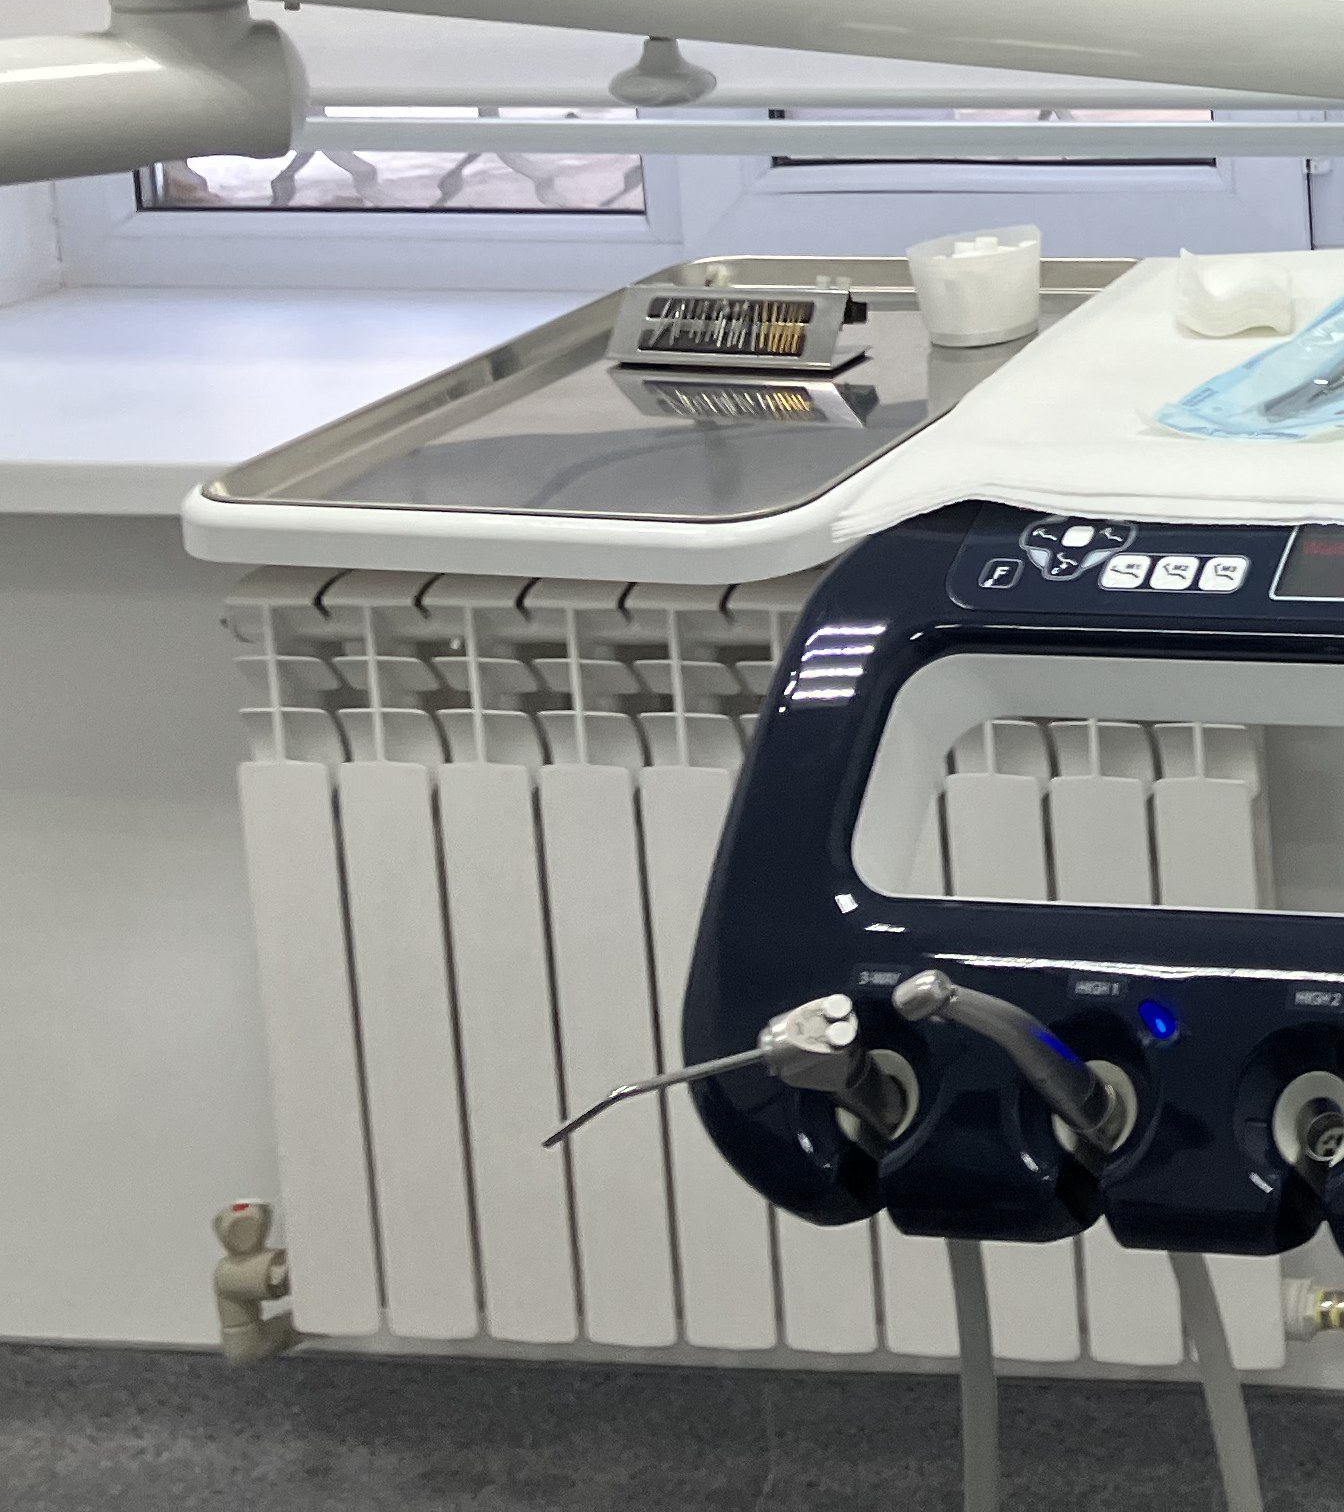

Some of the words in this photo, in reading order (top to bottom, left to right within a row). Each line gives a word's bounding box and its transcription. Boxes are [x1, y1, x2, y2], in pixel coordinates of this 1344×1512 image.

[994, 565, 1010, 582] F
[1173, 564, 1189, 572] M2
[1075, 980, 1110, 995] HIGH
[1295, 991, 1329, 1005] HIGH
